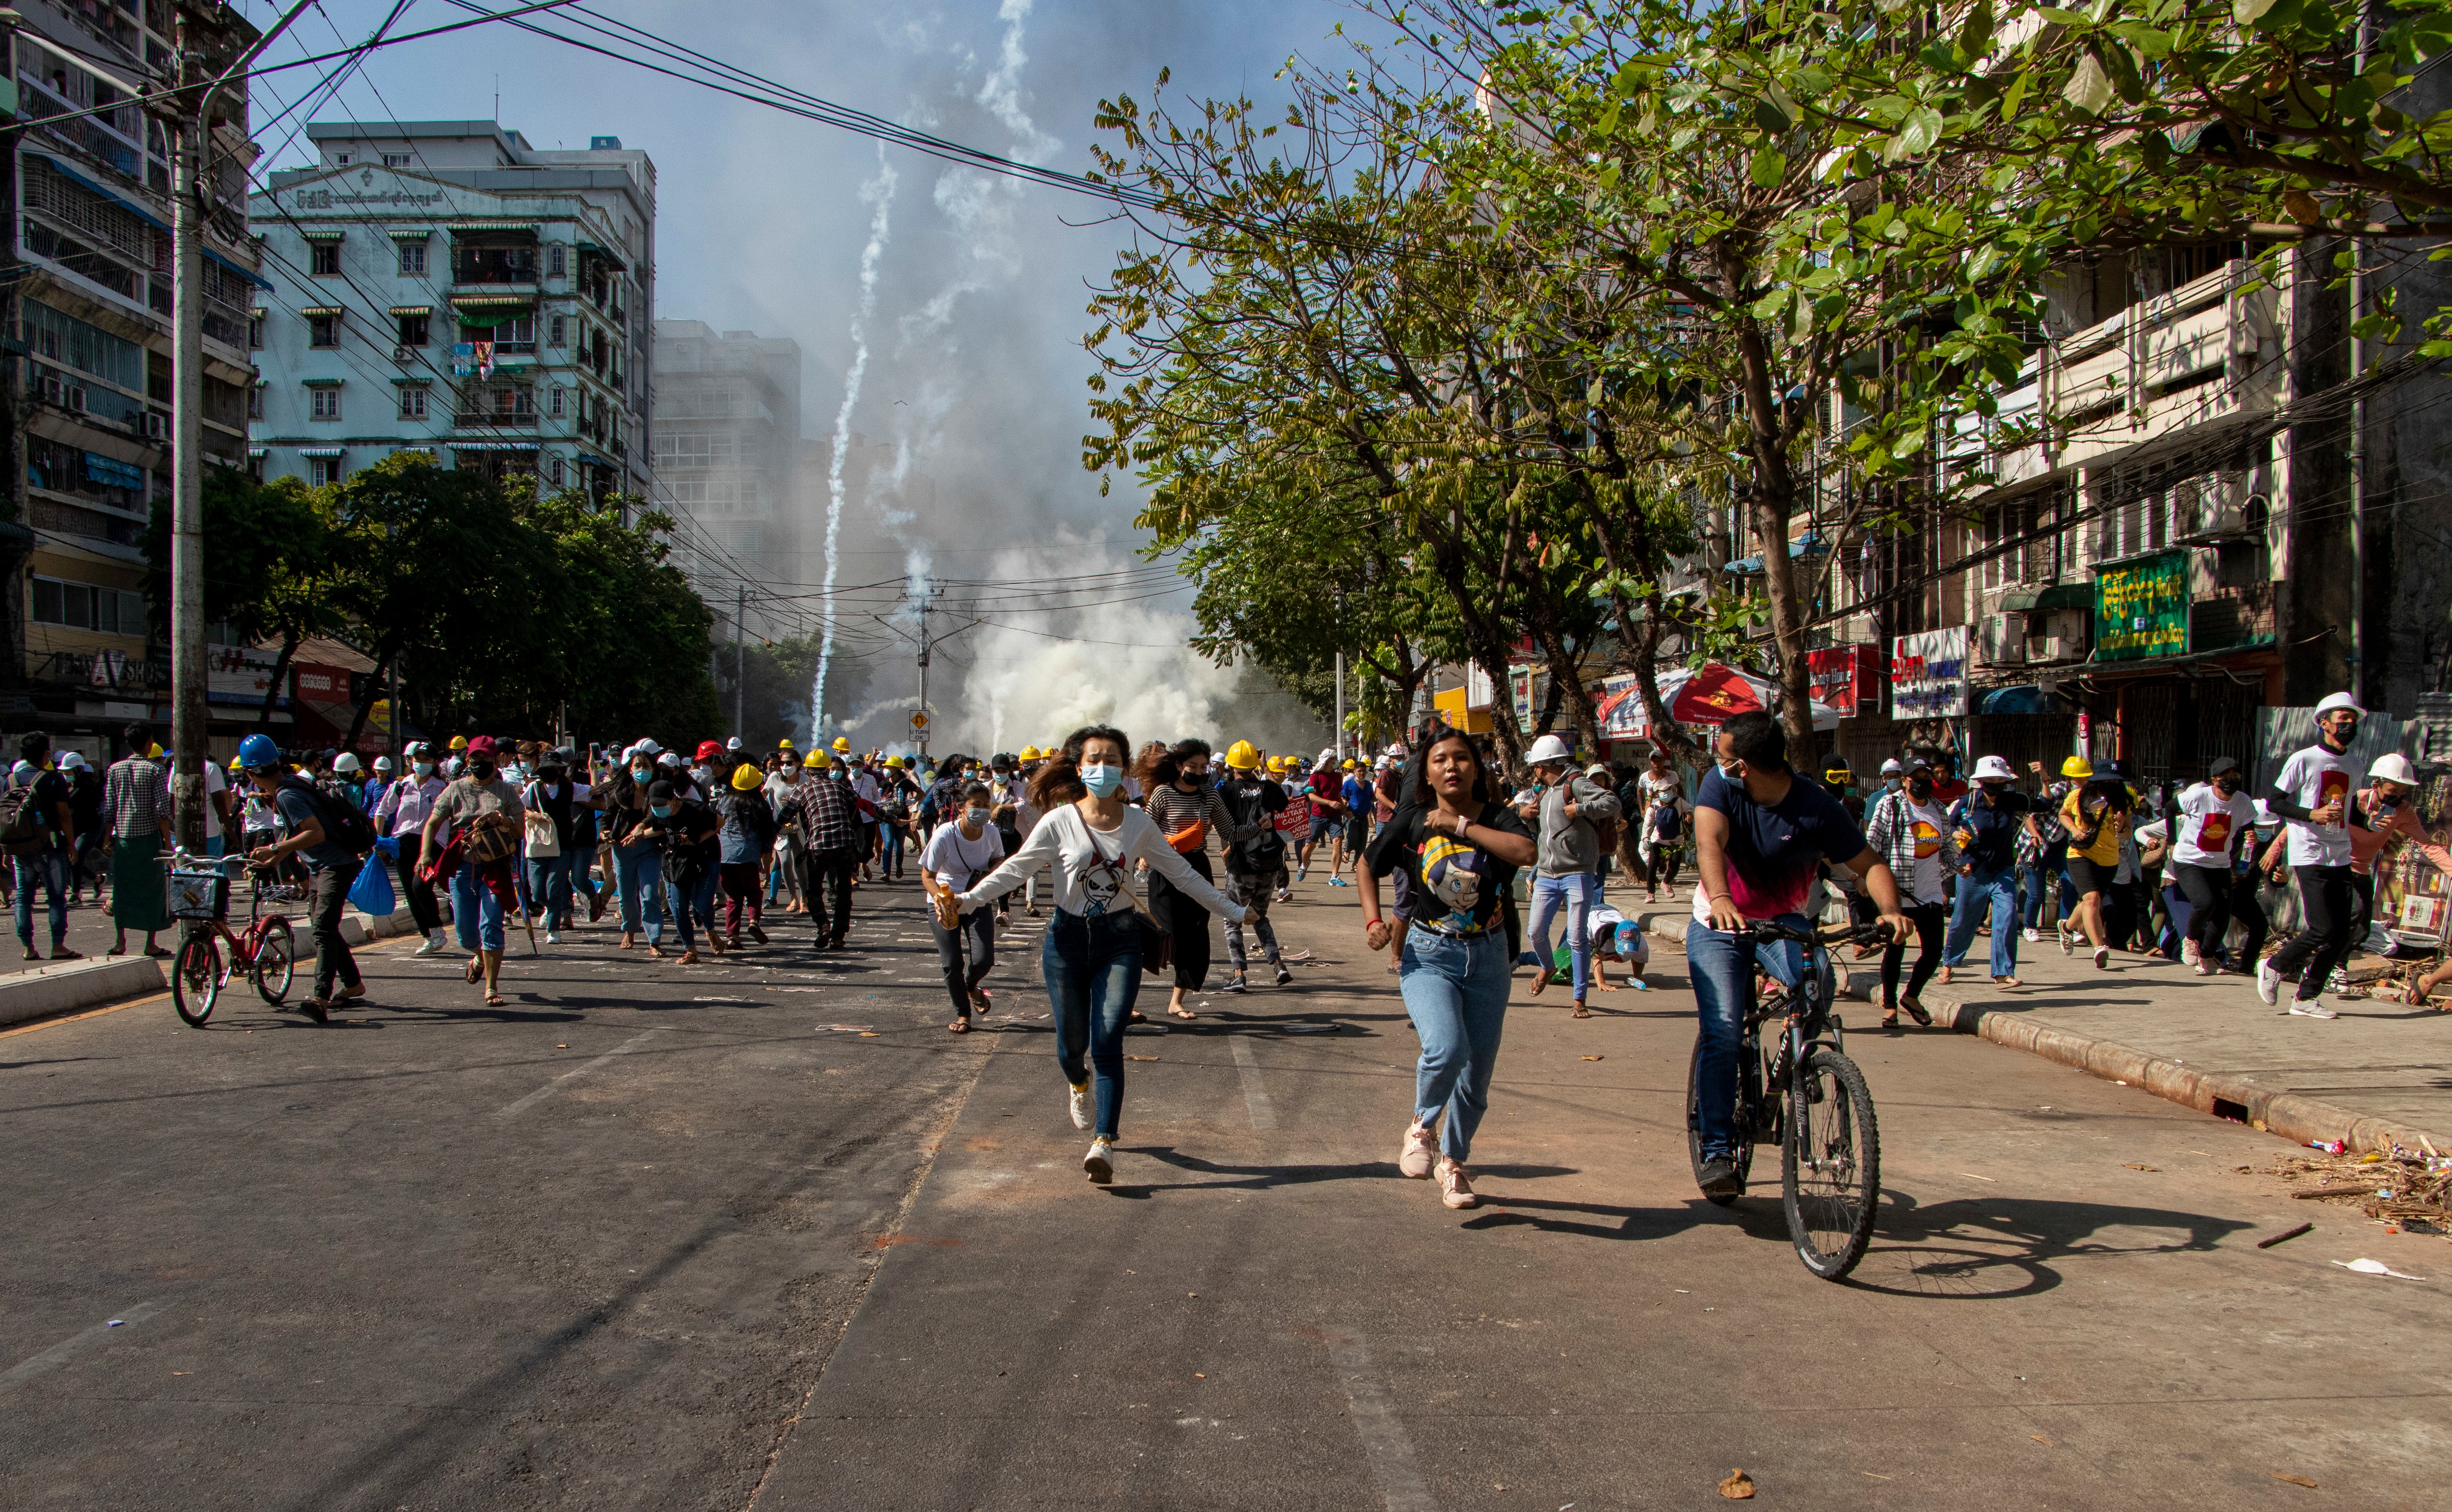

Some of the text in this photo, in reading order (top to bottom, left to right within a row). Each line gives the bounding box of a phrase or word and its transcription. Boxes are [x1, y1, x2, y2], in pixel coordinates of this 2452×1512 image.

[300, 673, 331, 691] ooredoo
[1710, 694, 1732, 707] 20
[1286, 800, 1305, 810] JECT
[1274, 807, 1308, 820] MILITARY
[1282, 815, 1303, 825] COUP
[1292, 823, 1310, 833] JOIN
[1295, 829, 1310, 839] CDM
[1772, 998, 1784, 1009] CX50
